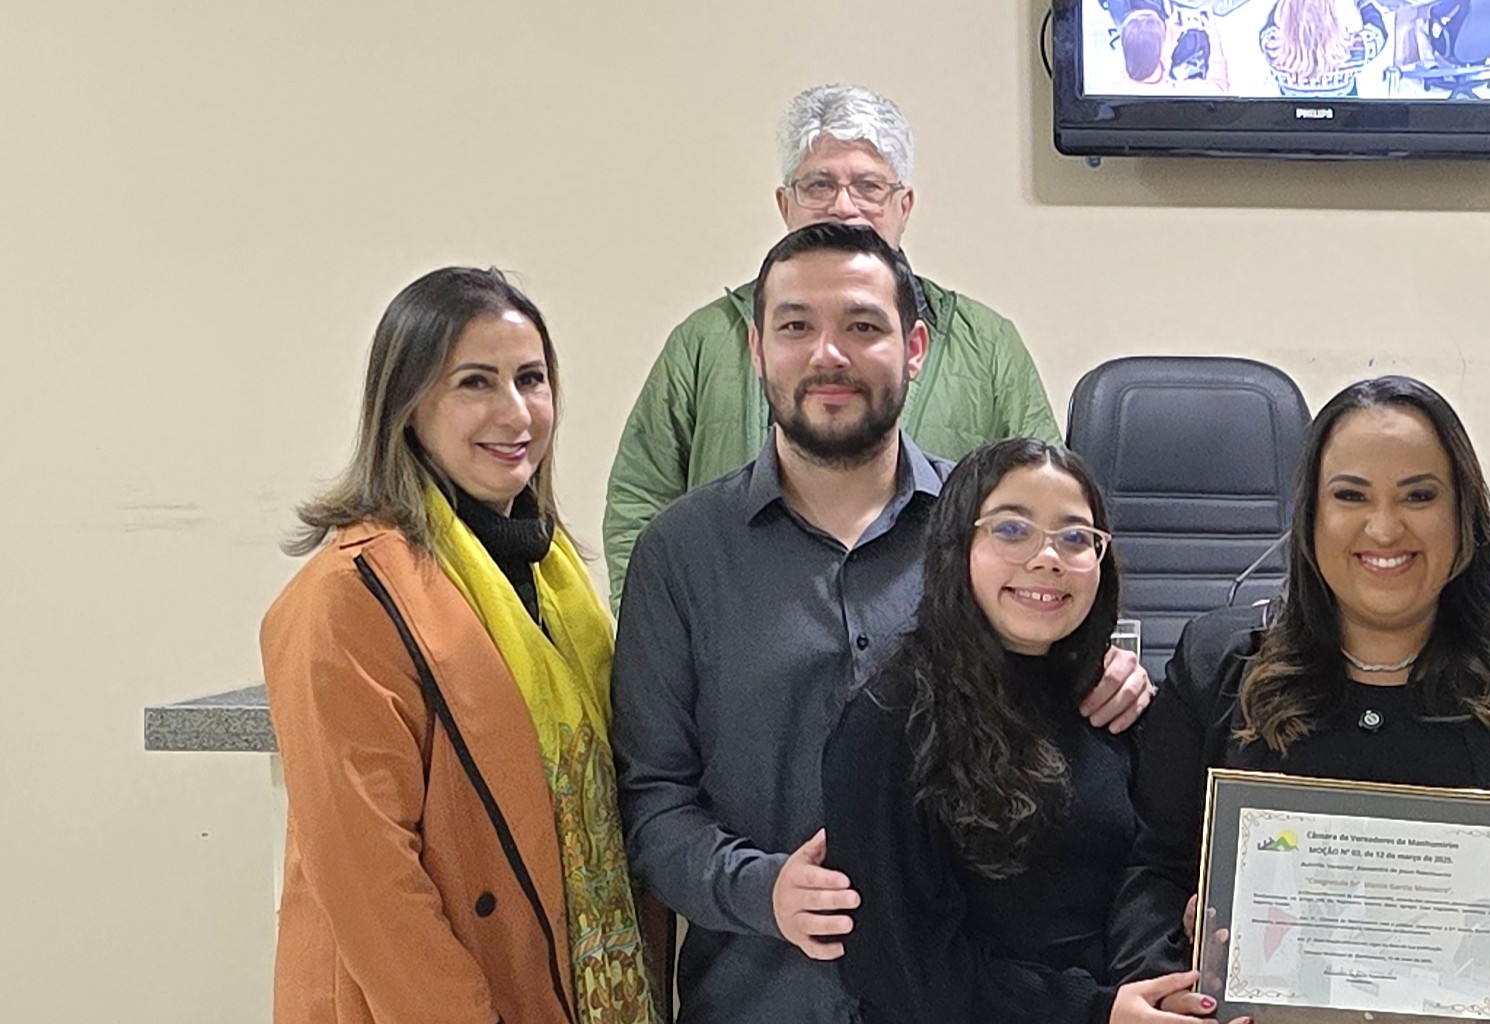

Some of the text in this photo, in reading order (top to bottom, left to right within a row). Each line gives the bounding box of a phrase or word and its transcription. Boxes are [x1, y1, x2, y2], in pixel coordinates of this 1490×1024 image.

[1306, 831, 1338, 840] Câmara
[1350, 834, 1395, 845] Vereadores
[1308, 846, 1339, 857] MOÇÃO
